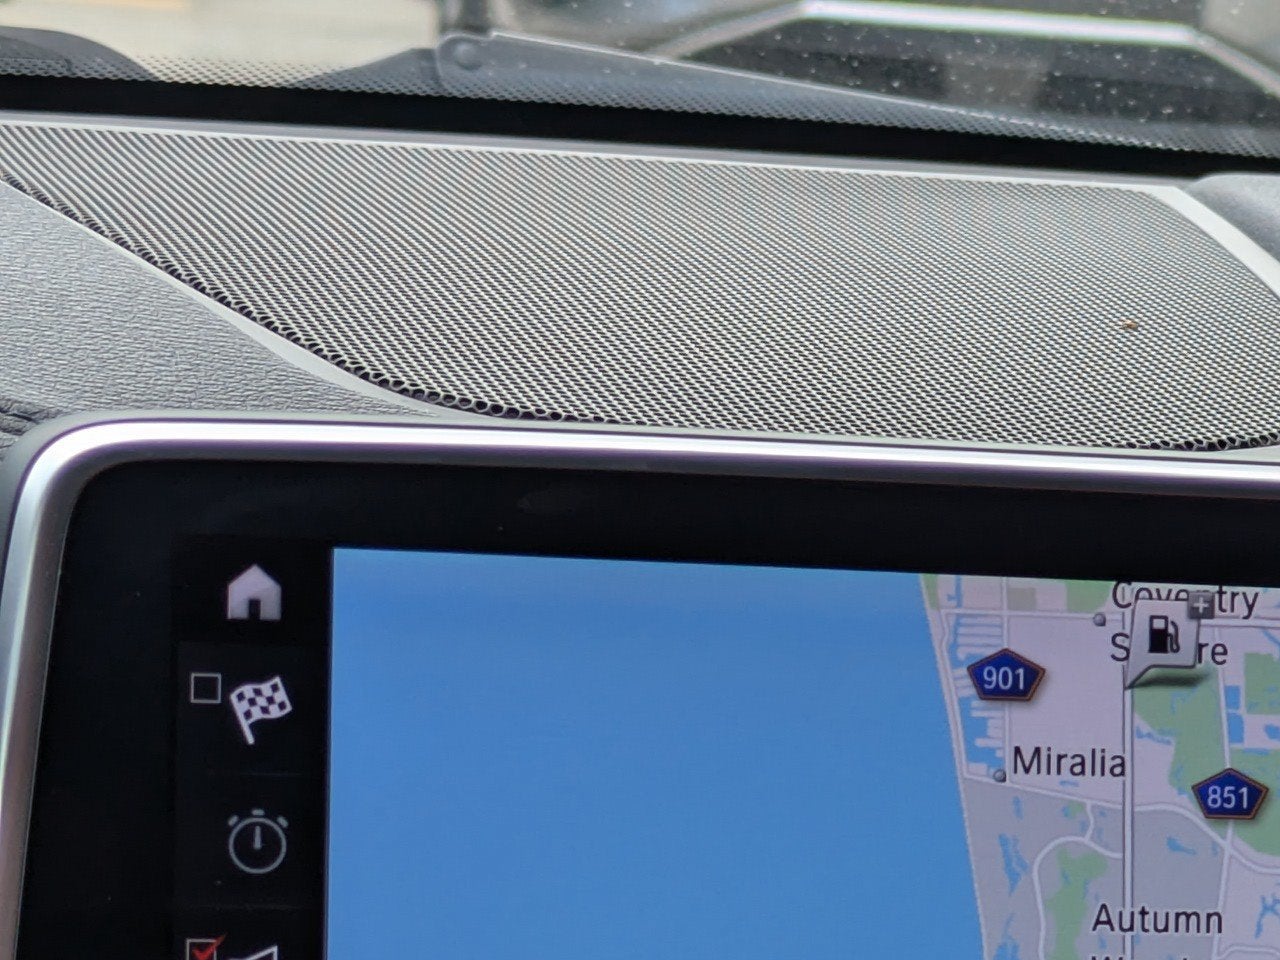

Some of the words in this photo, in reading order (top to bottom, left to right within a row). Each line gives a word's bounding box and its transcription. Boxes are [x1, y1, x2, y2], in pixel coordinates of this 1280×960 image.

[1112, 580, 1260, 619] Covetry
[1110, 632, 1229, 666] Sre
[982, 666, 1027, 691] 901
[1013, 746, 1126, 778] Miralia
[1207, 786, 1250, 810] 851
[1092, 903, 1223, 934] Autumn
